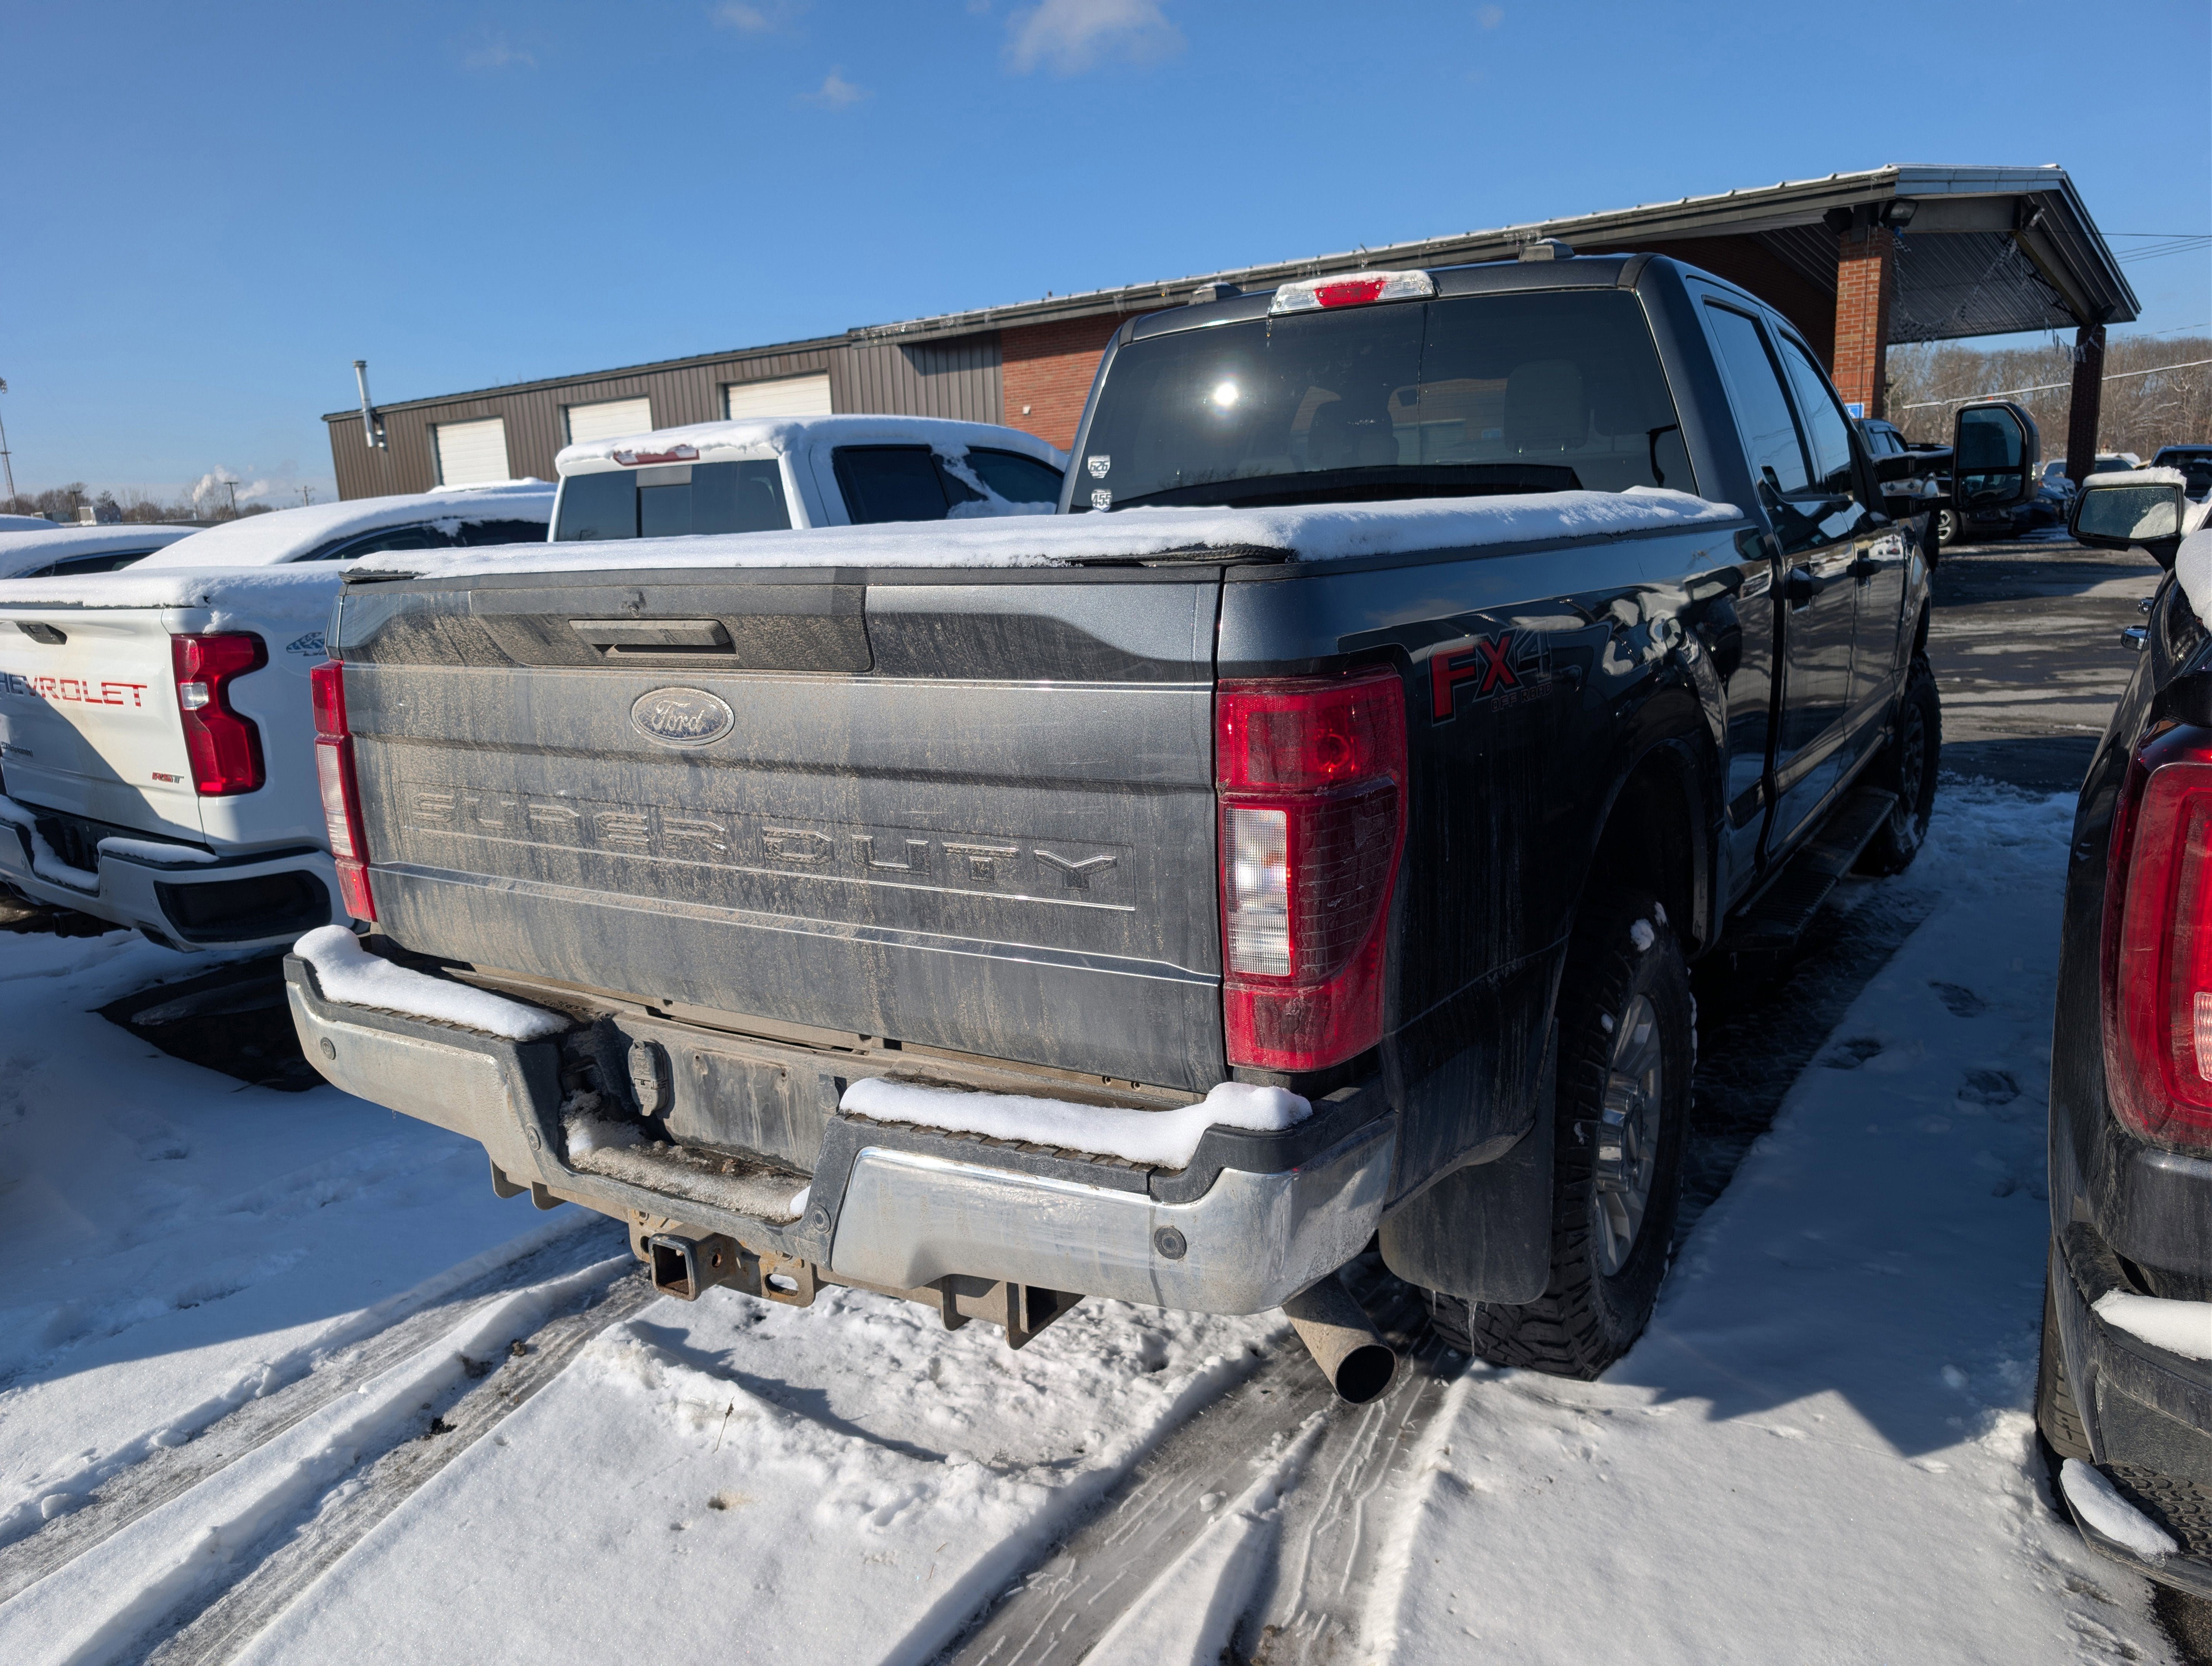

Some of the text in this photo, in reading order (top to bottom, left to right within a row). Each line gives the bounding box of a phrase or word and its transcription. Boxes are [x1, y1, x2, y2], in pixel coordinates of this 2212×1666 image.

[1090, 460, 1109, 472] 626
[1093, 494, 1111, 506] 455
[0, 672, 147, 708] HEVROLET
[1427, 621, 1552, 727] FX4
[1491, 681, 1553, 712] OFF ROAD
[651, 700, 706, 733] Ford
[152, 772, 184, 784] RST
[411, 792, 1118, 890] SUPER DUTY
